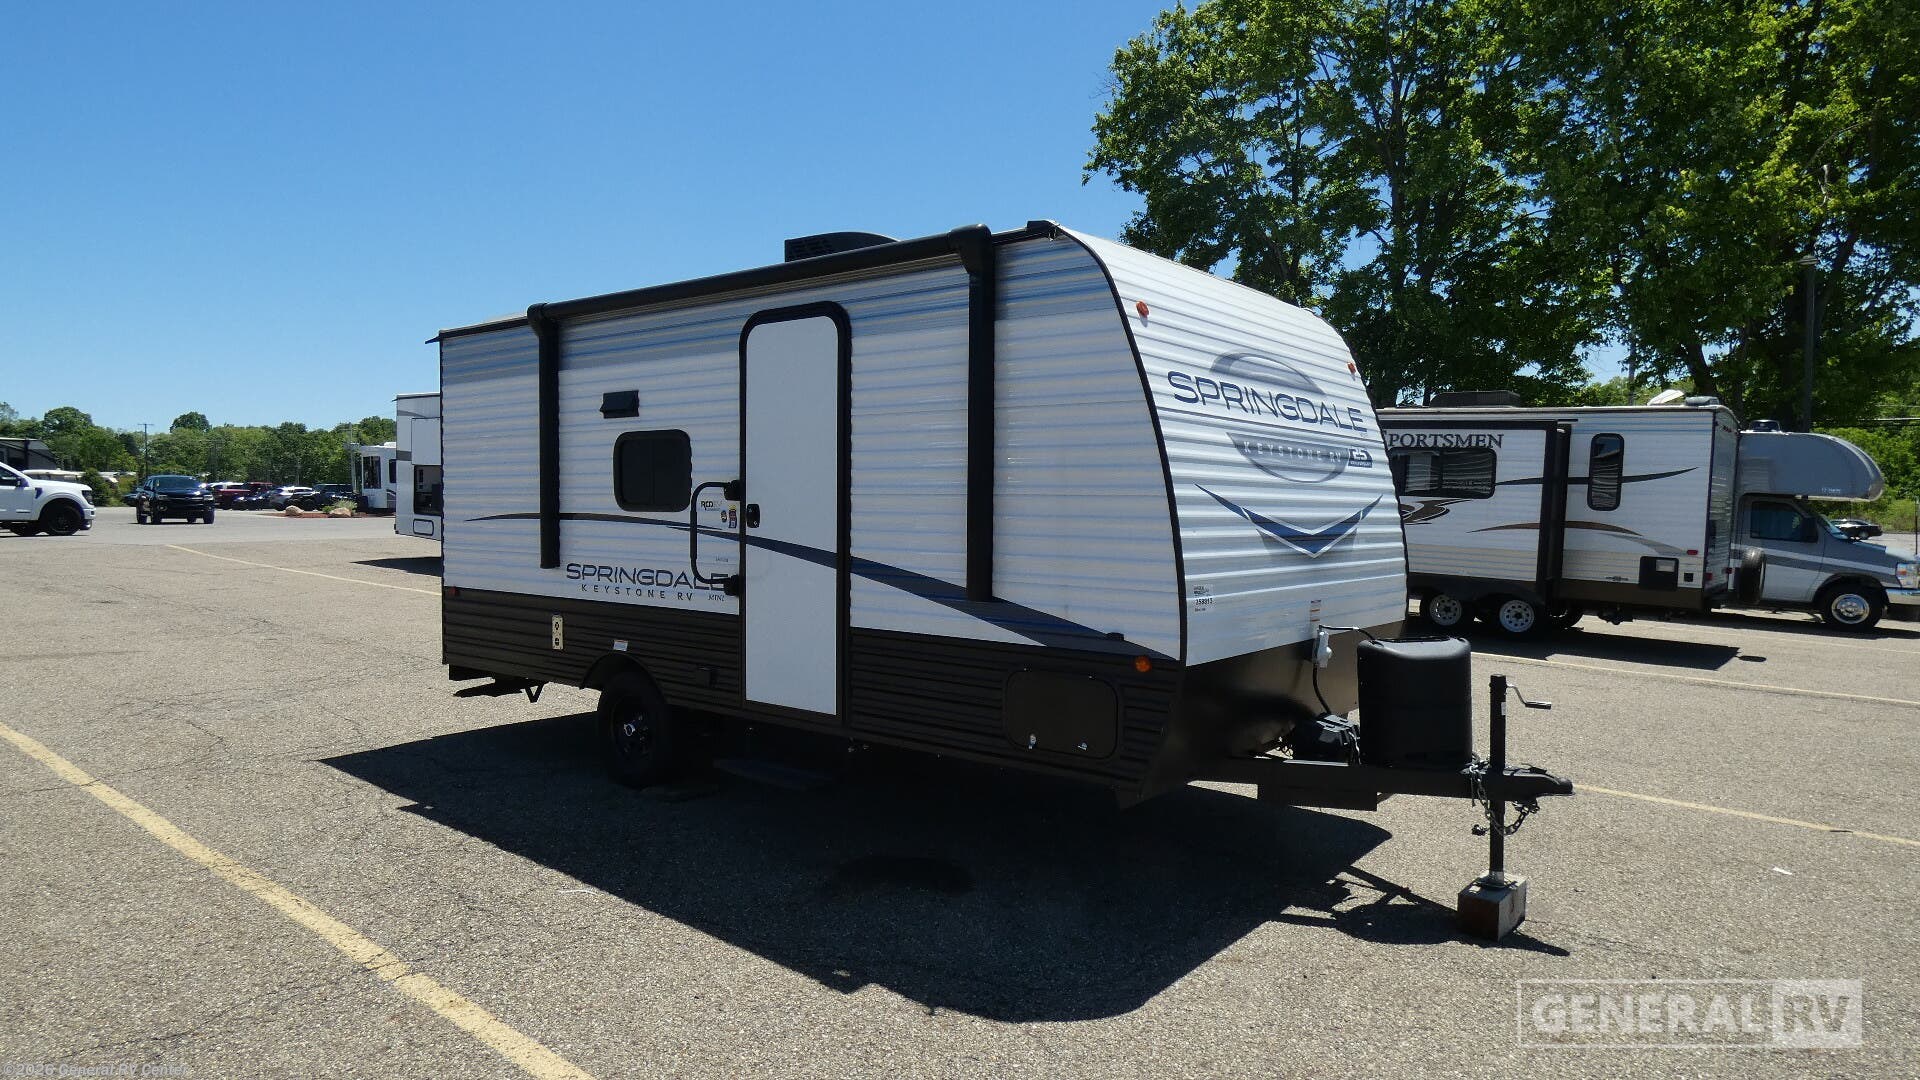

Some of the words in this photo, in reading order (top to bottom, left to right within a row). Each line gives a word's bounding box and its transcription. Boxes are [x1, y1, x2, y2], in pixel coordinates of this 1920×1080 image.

[1167, 370, 1368, 433] SPRINGDALE
[1385, 429, 1505, 449] PORTSMEN
[1244, 440, 1322, 460] KEYSTONE
[1329, 450, 1342, 463] RV
[566, 562, 729, 592] SPRINGDALE
[581, 584, 666, 599] KEYSTONE
[677, 592, 693, 601] RV
